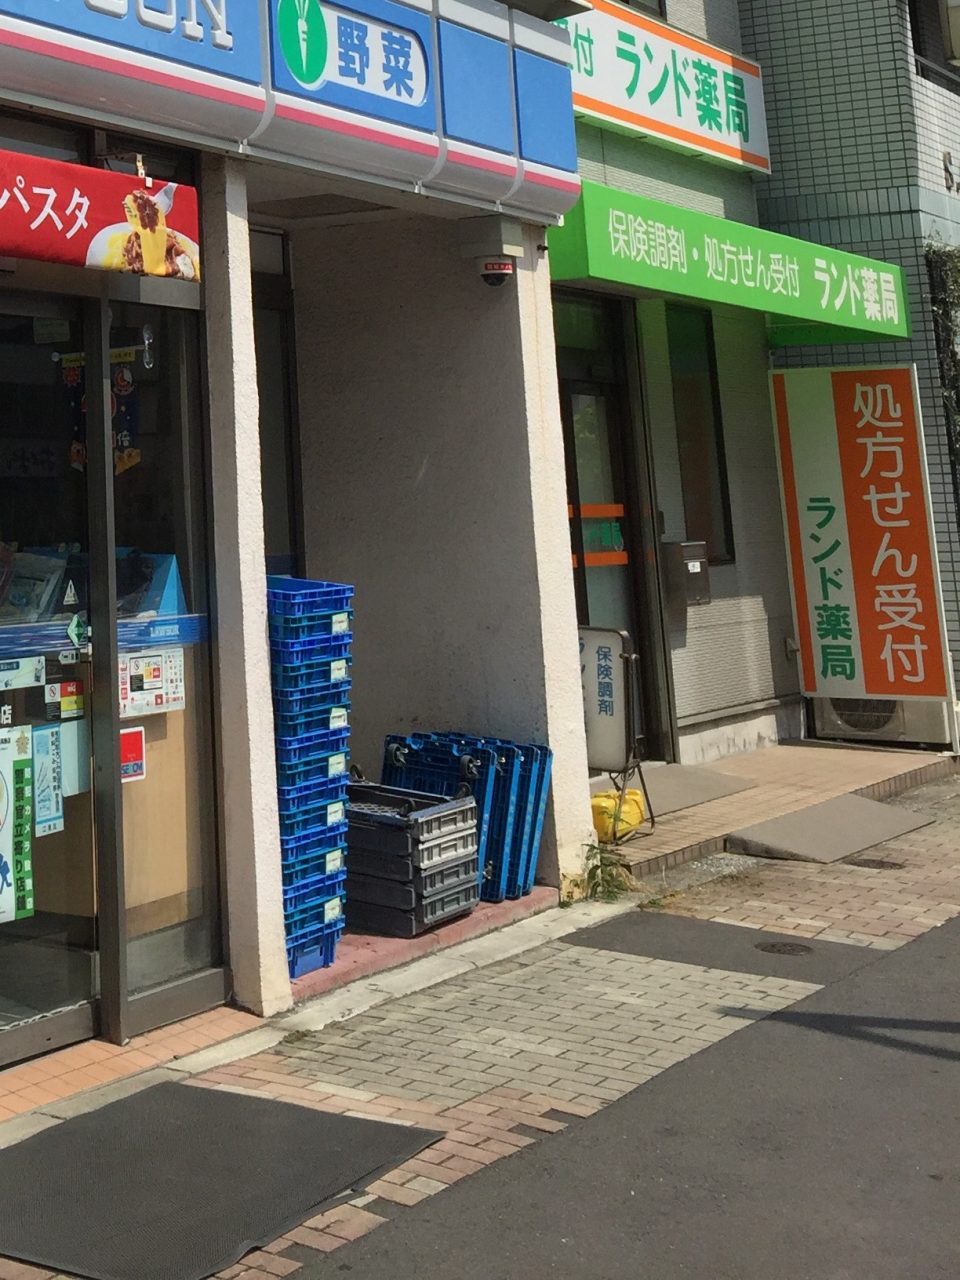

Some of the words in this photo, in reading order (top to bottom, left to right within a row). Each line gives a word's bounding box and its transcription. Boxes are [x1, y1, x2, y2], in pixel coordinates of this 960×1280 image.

[337, 15, 416, 99] 野菜
[549, 18, 595, 78] 付
[615, 28, 751, 144] ランド薬局
[813, 258, 900, 325] ランド薬局
[853, 382, 928, 683] 処方せん受付
[806, 497, 856, 680] ランド薬局
[595, 645, 615, 717] 保険調剤
